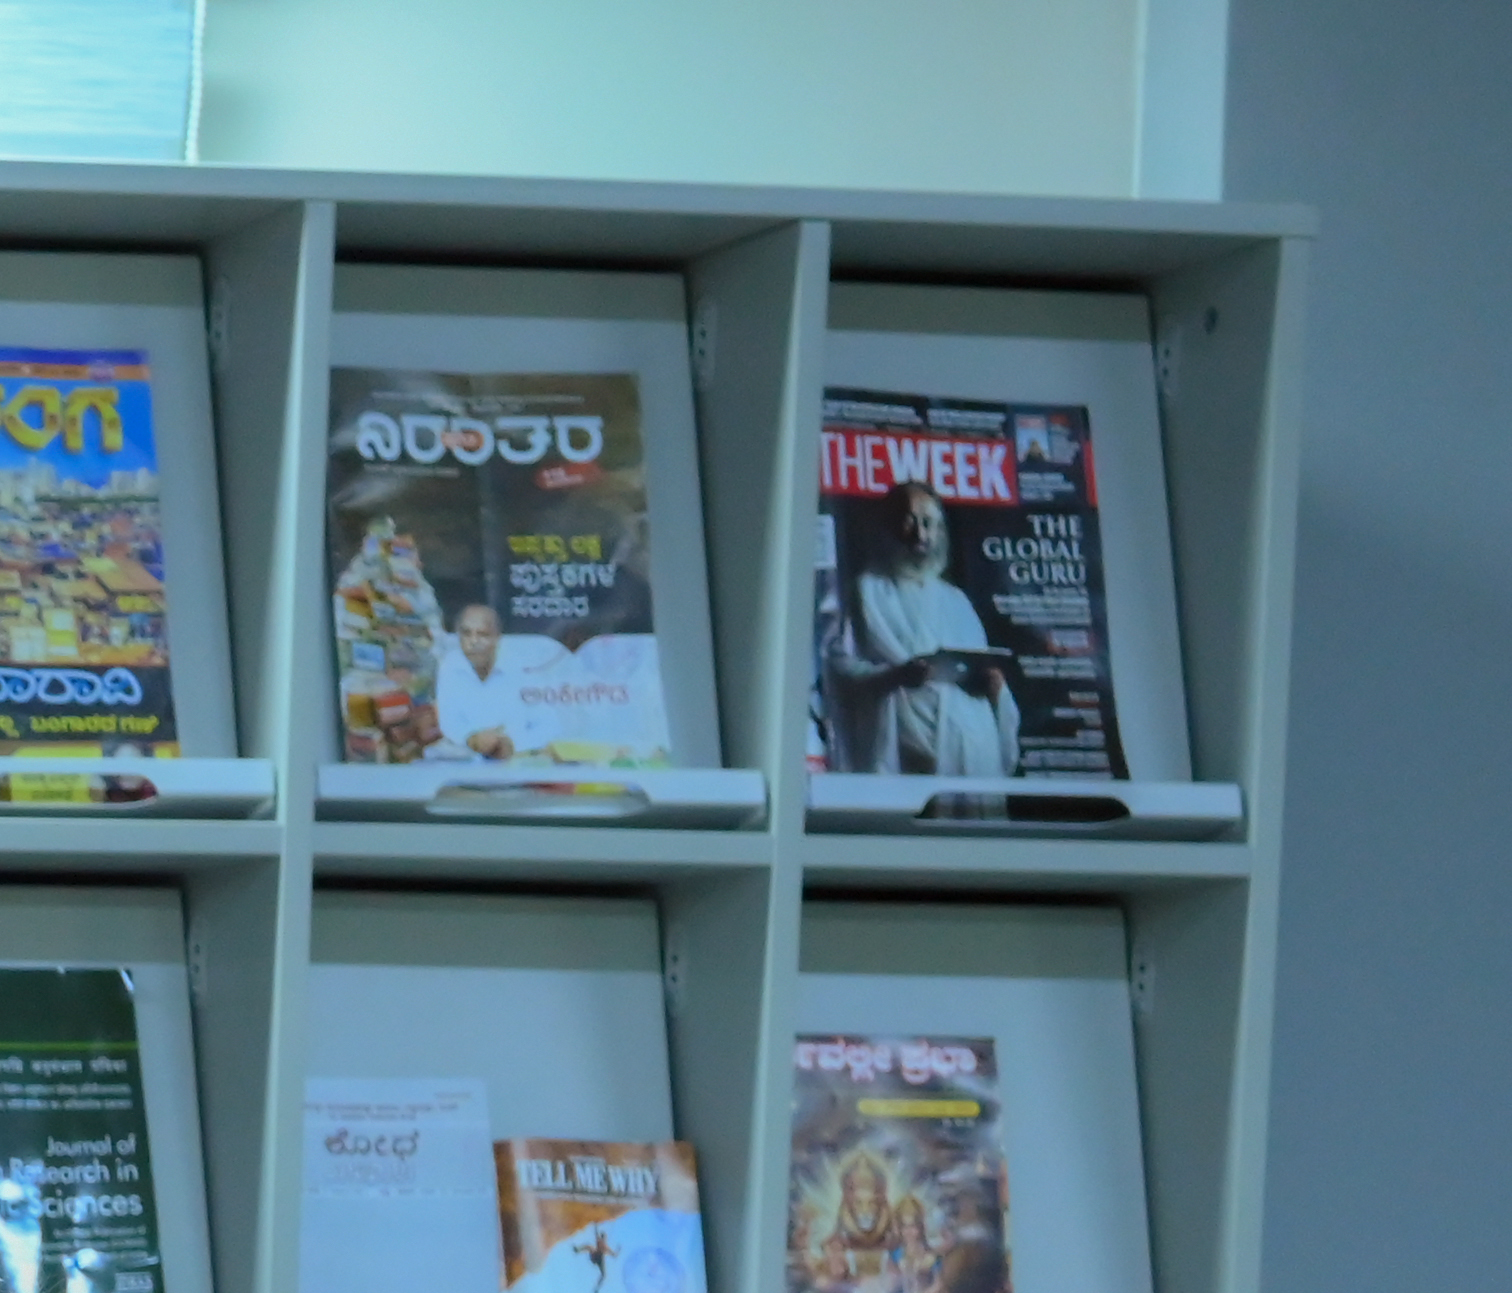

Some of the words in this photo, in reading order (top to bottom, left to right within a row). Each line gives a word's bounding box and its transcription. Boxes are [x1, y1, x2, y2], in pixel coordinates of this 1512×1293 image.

[820, 431, 888, 493] THE
[885, 437, 1012, 500] WEEK
[1027, 514, 1083, 538] THE
[982, 536, 1083, 561] GLOBAL
[1008, 561, 1086, 585] GURU
[47, 1133, 111, 1157] Journal
[116, 1132, 136, 1155] of
[116, 1157, 138, 1182] in
[516, 1159, 572, 1190] TELL
[575, 1162, 607, 1192] ME
[608, 1167, 660, 1195] WHY
